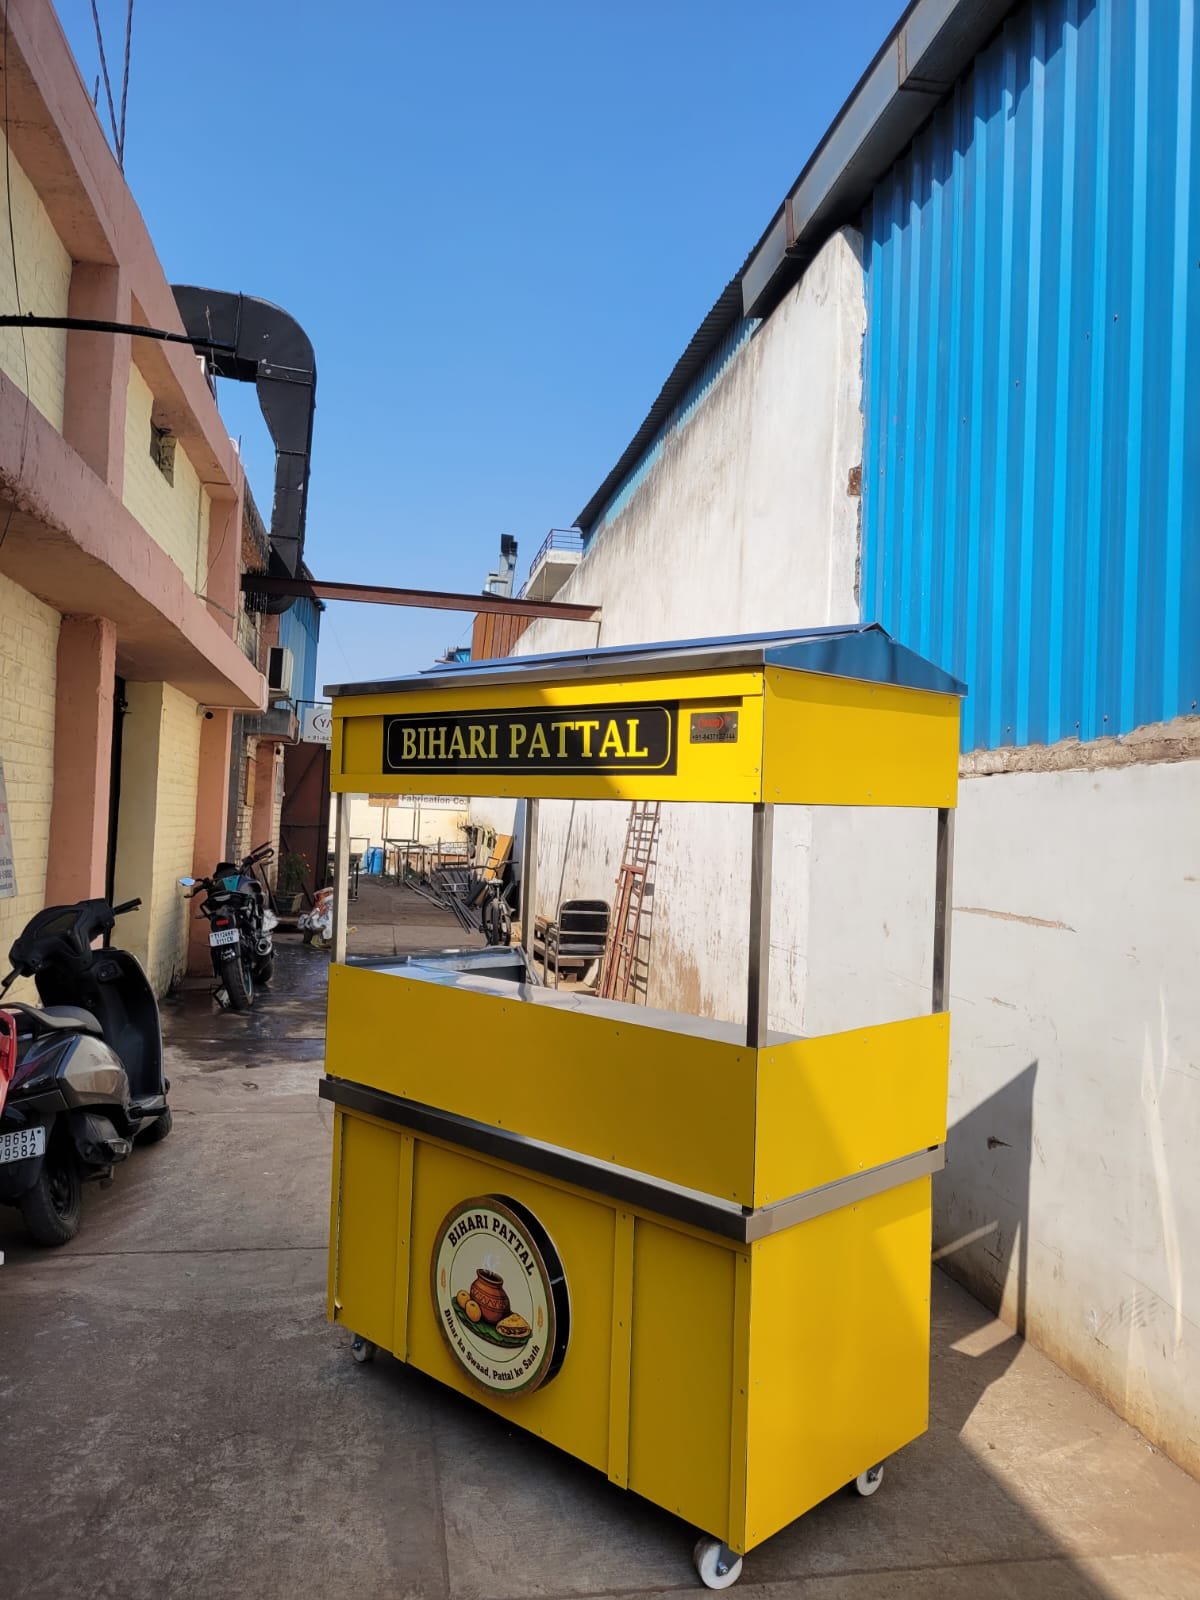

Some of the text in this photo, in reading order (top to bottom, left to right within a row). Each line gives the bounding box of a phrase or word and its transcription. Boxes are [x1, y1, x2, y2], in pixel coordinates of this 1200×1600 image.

[401, 719, 649, 760] BIHARI PATTAL
[401, 794, 450, 805] Fabrication
[0, 1143, 36, 1160] 9582
[448, 1214, 535, 1276] BIHARI PATTAL
[444, 1308, 541, 1381] Bihar ka Swaad, Pattal ke Saath
